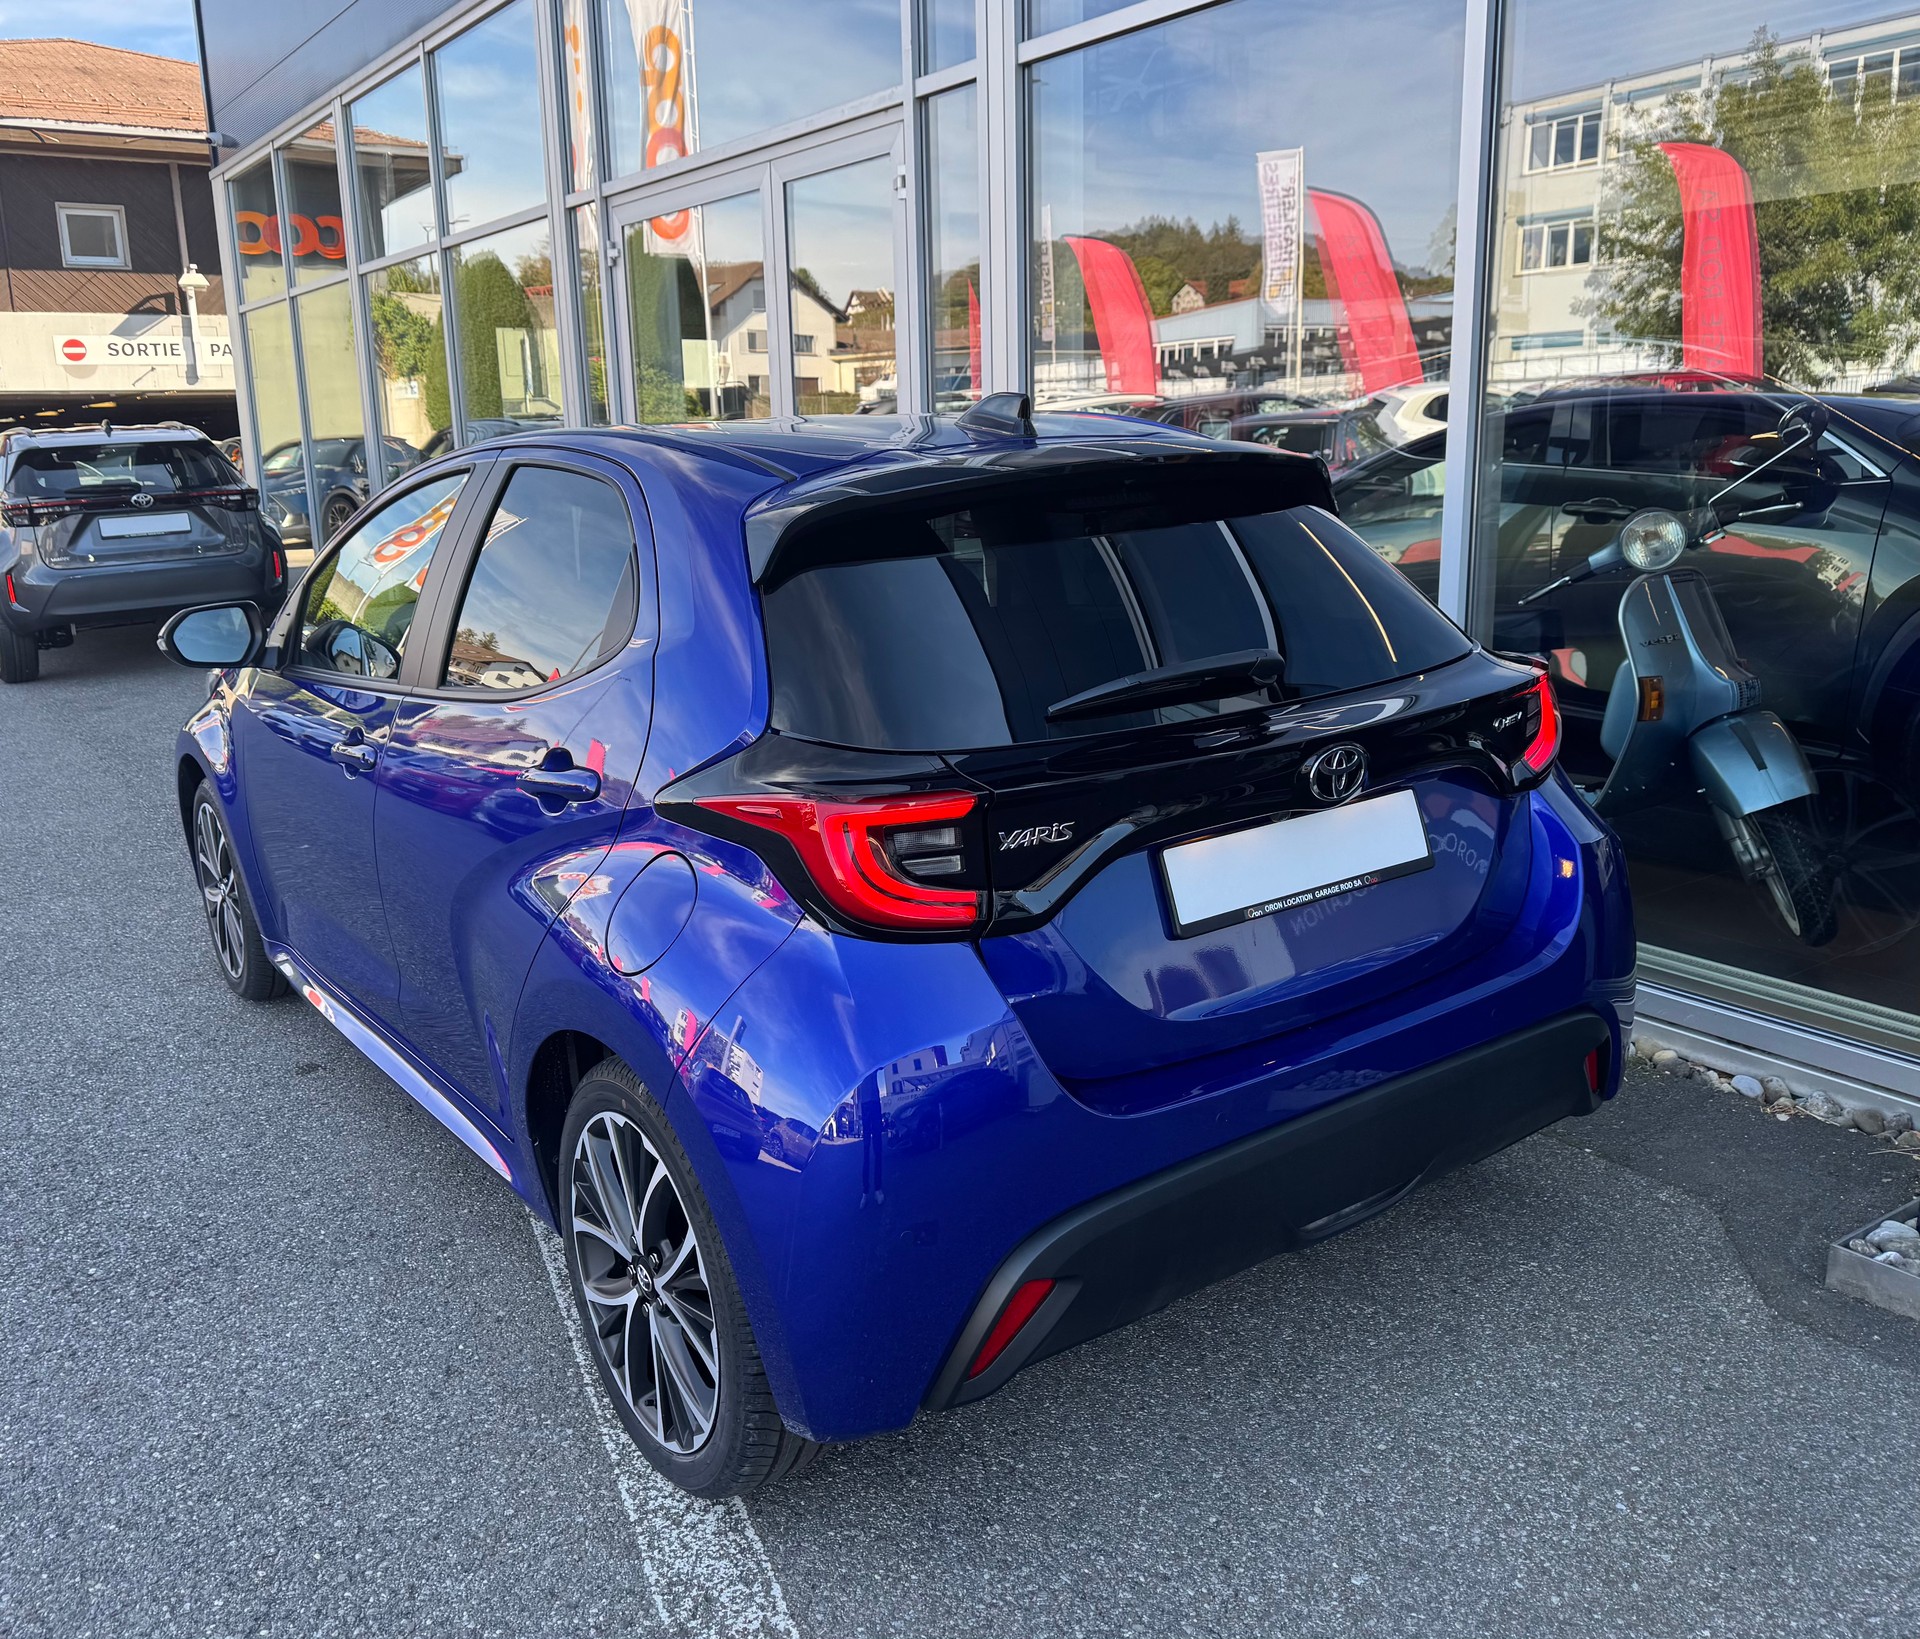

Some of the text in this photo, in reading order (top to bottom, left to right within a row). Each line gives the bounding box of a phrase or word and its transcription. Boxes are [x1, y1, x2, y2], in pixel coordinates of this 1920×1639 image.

[107, 343, 181, 357] SORTIE
[1264, 902, 1284, 913] ORON
[1283, 893, 1313, 908] LOCATION
[1315, 884, 1341, 898] GARAGE
[1340, 881, 1353, 891] ROD
[1353, 878, 1363, 888] SA
